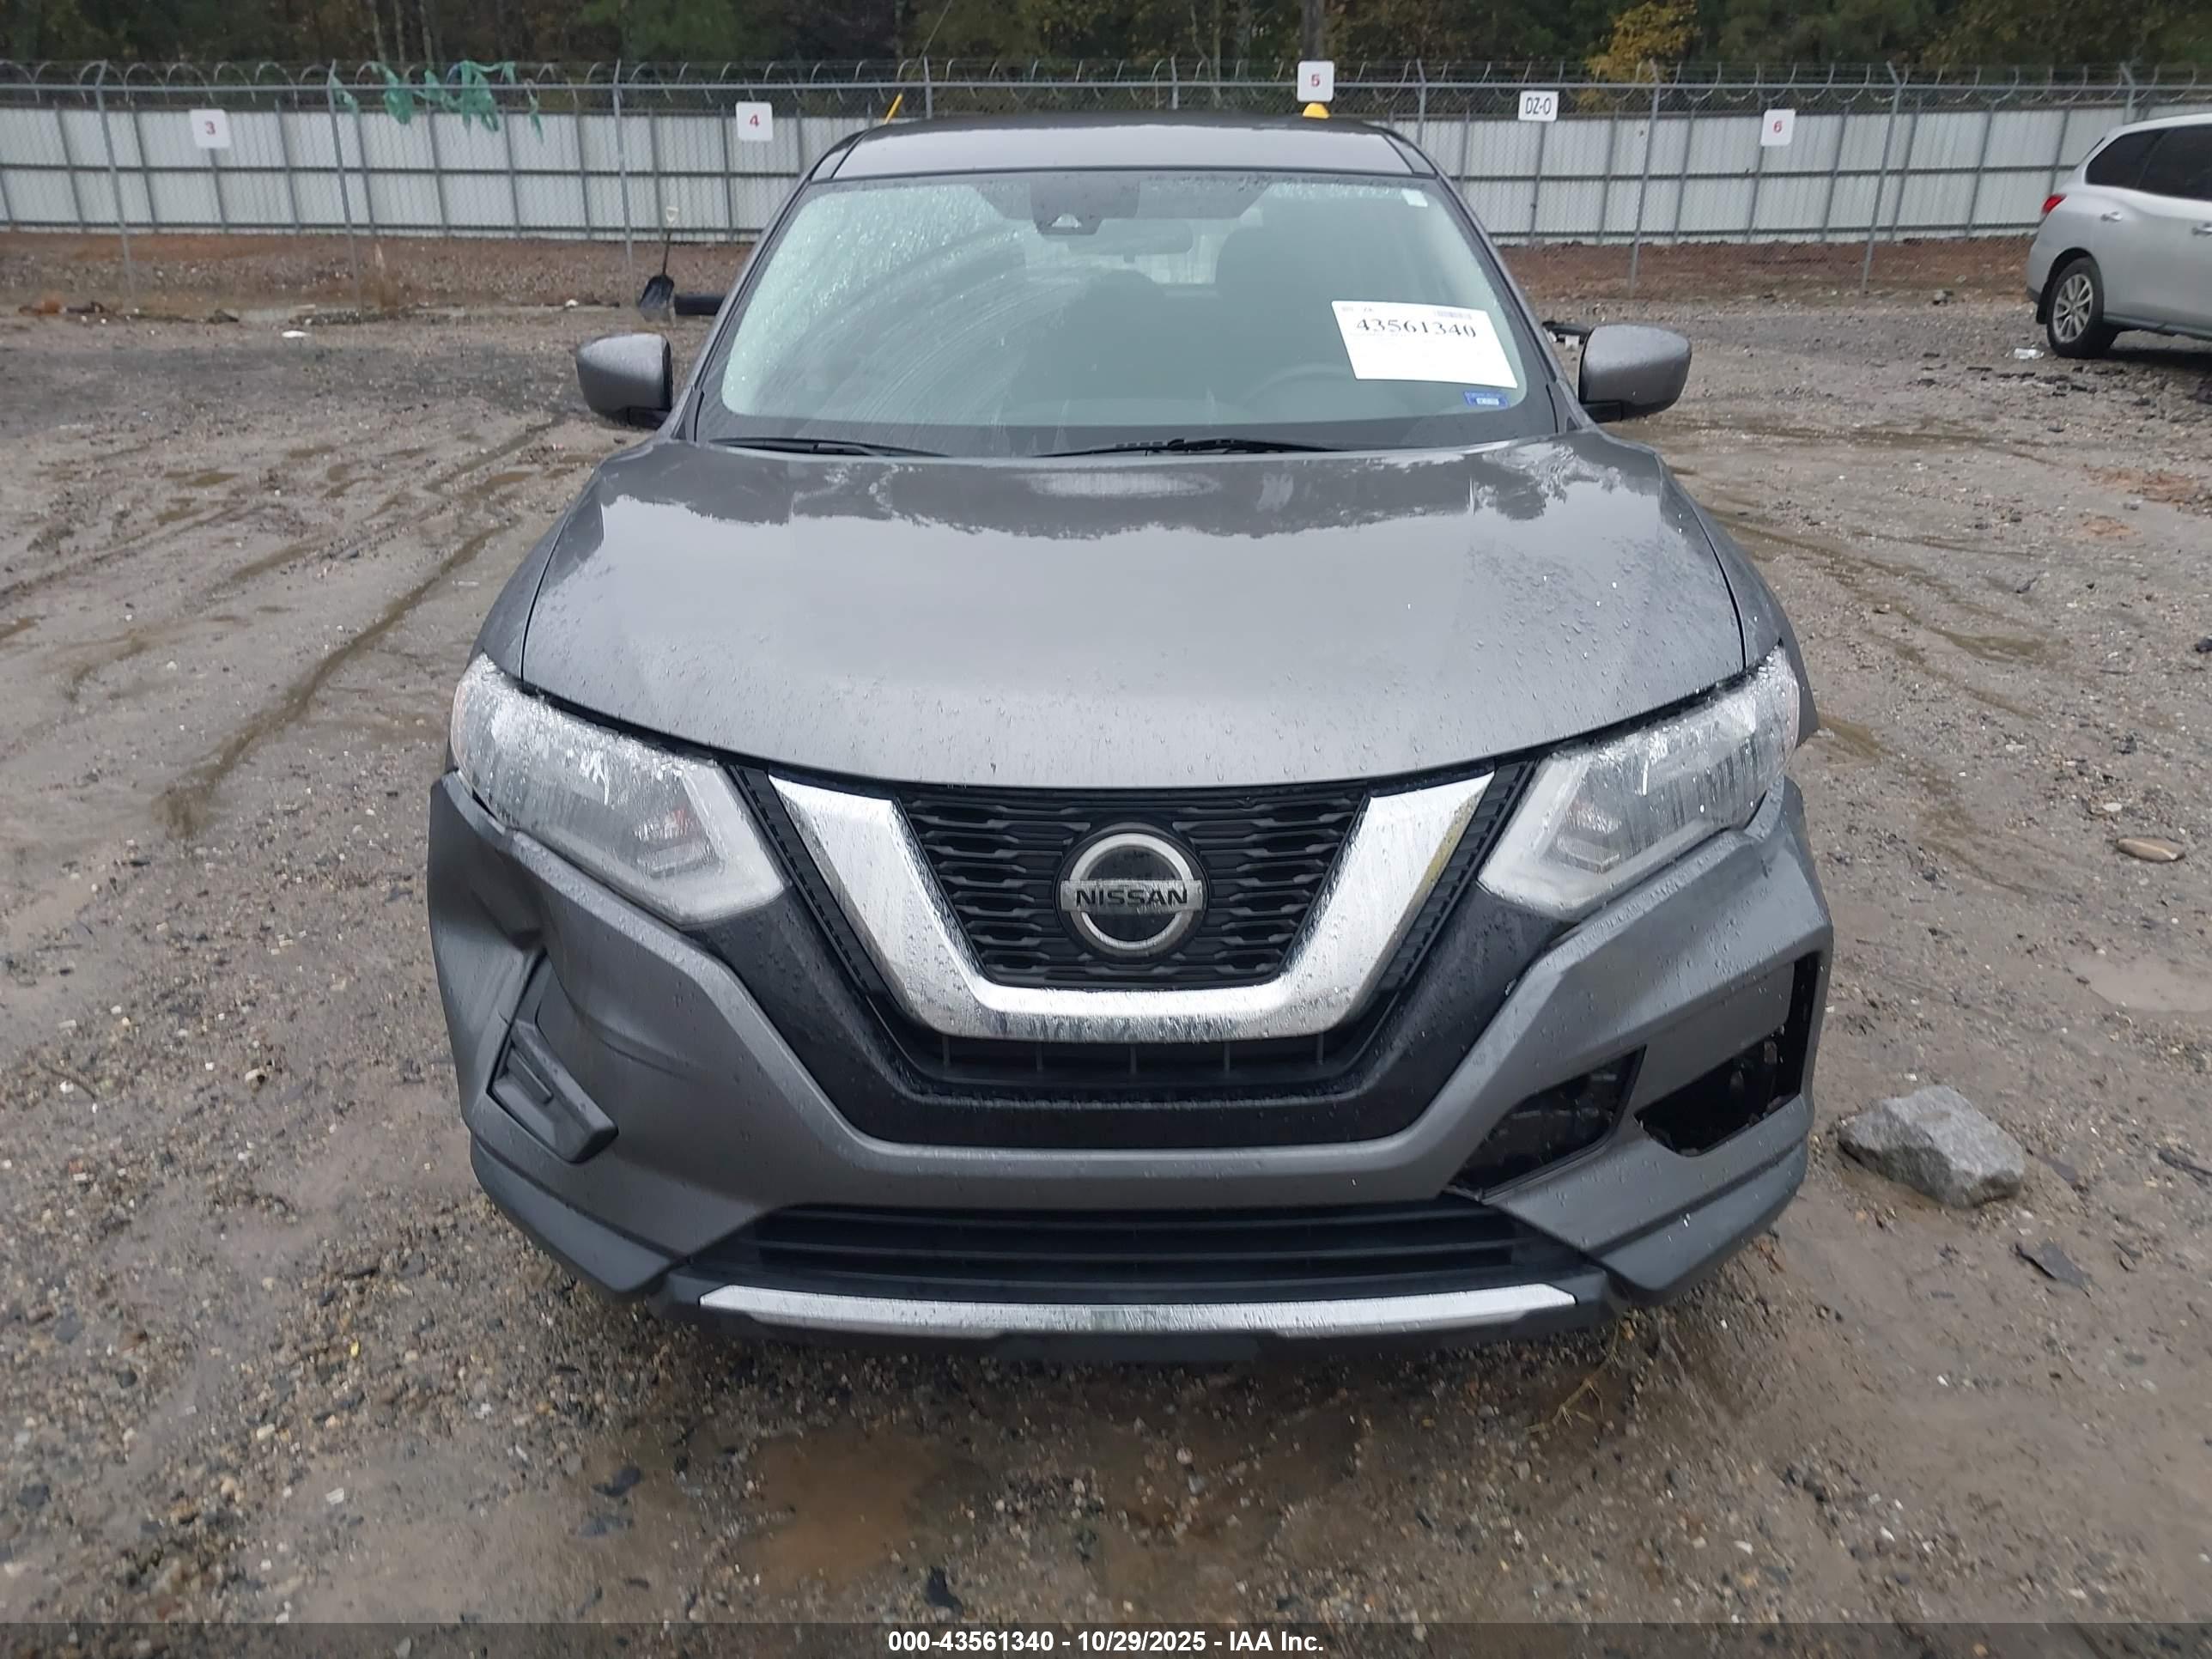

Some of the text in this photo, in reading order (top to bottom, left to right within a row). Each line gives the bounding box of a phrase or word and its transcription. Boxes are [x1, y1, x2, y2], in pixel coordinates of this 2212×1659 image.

[1310, 74, 1321, 88] 5
[204, 120, 216, 136] 3
[749, 113, 760, 128] 4
[1772, 120, 1783, 134] 6
[1357, 318, 1477, 337] 43561340
[1076, 889, 1188, 907] NISSAN
